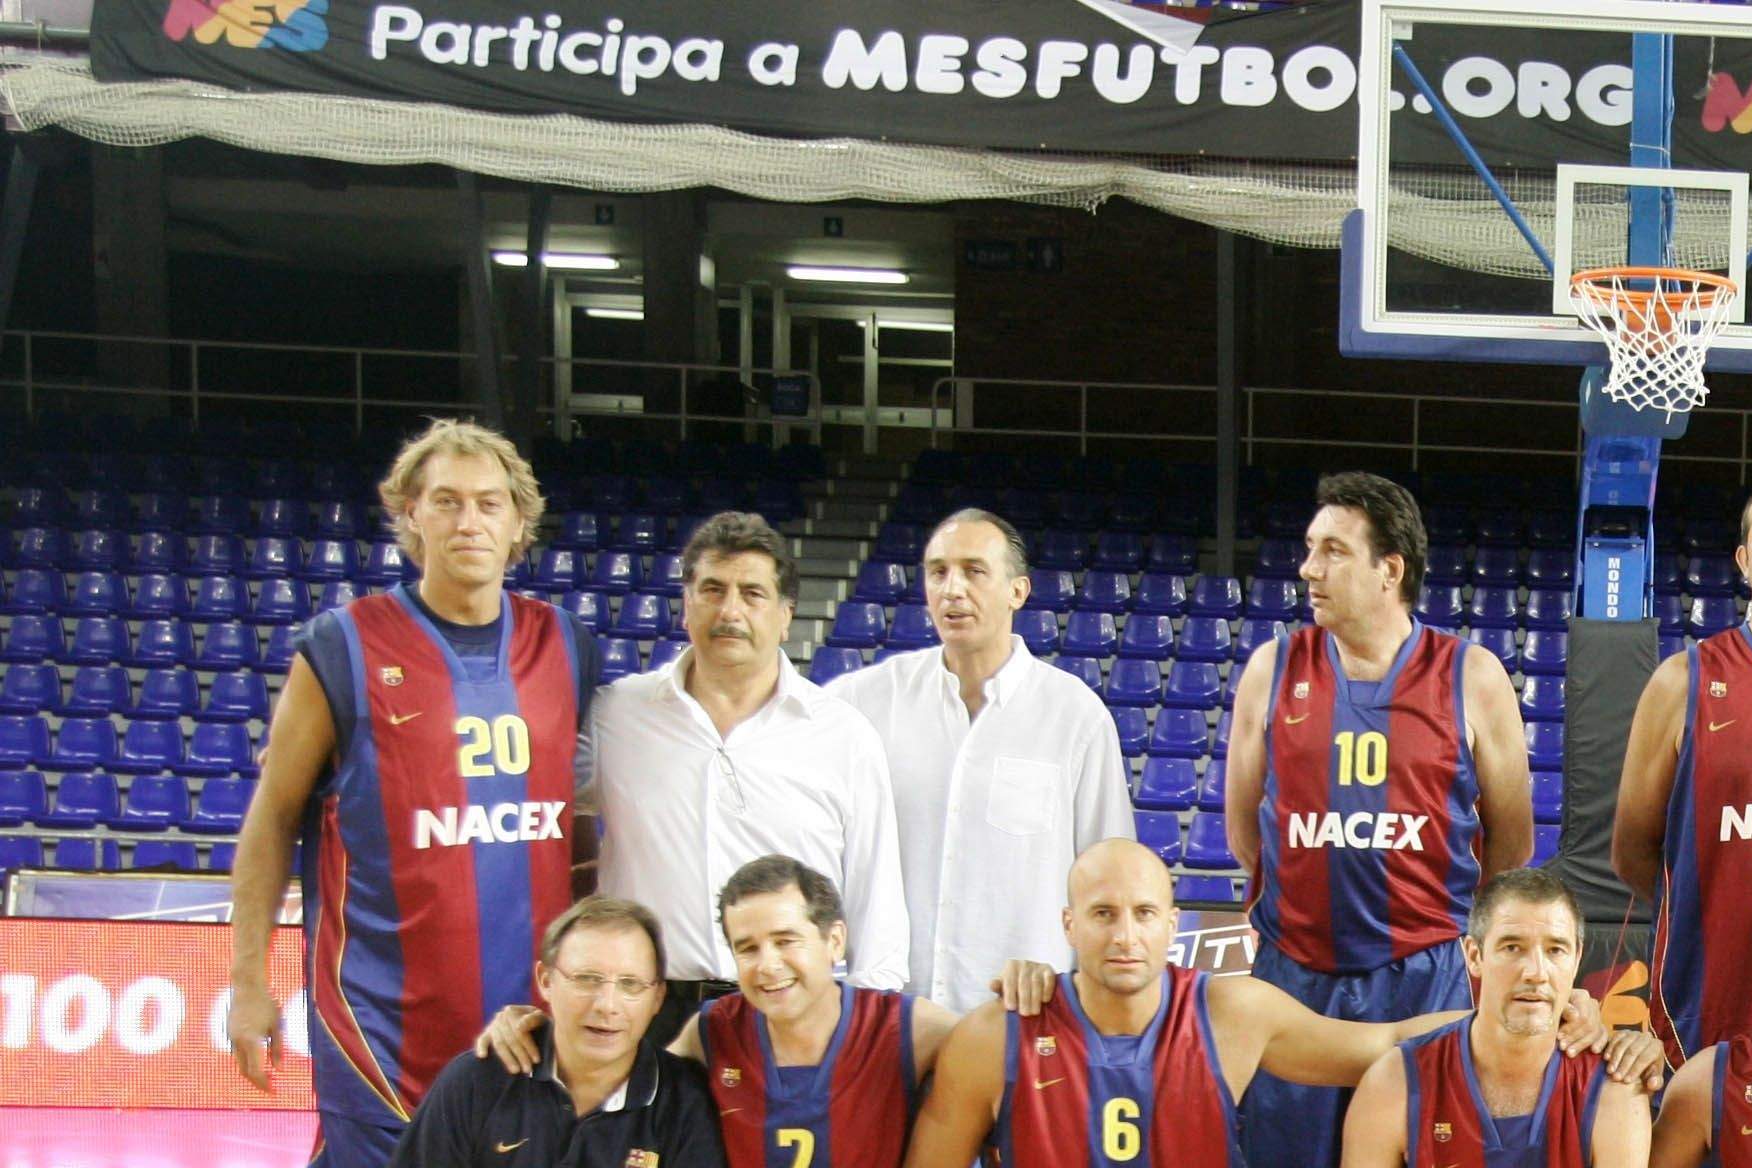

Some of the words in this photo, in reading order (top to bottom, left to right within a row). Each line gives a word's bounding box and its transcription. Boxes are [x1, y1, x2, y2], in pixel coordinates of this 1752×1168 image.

[371, 5, 724, 96] Participa
[748, 43, 800, 86] a
[821, 28, 1634, 126] MESFUTBO.ORG
[1606, 557, 1621, 618] MONDO
[453, 714, 532, 777] 20
[1334, 730, 1389, 787] 10
[414, 800, 566, 849] NACEX
[1287, 811, 1430, 852] NACEX
[0, 972, 186, 1055] 100
[1101, 1096, 1142, 1163] 6
